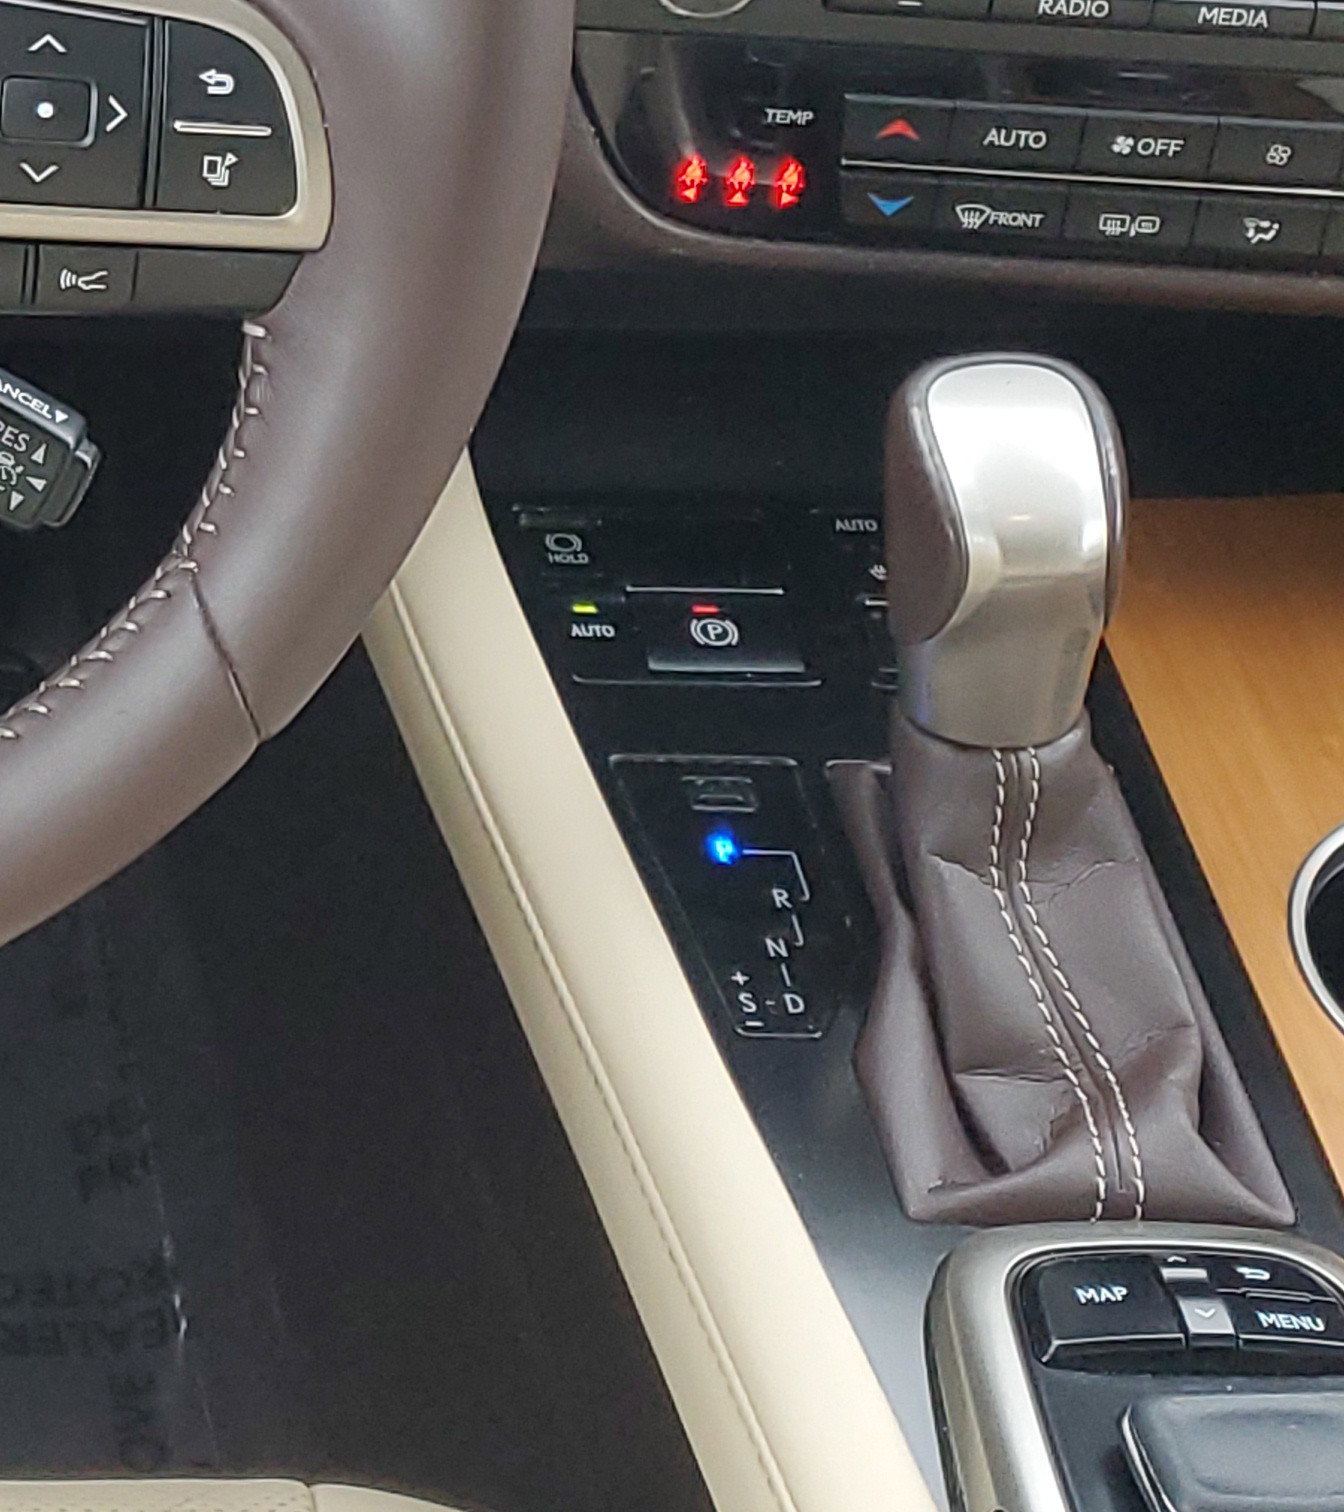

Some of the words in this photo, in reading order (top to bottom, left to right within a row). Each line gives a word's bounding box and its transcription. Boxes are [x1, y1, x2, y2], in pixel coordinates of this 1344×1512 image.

[1197, 6, 1269, 28] MEDIA
[765, 108, 814, 125] TEMP
[983, 129, 1047, 150] AUTO
[1136, 138, 1184, 158] OFF
[989, 210, 1043, 230] FRONT
[835, 518, 878, 533] AUTO
[548, 552, 589, 565] HOLD
[570, 623, 615, 639] AUTO
[771, 888, 792, 909] R
[765, 938, 788, 957] N
[738, 993, 757, 1013] S
[783, 993, 805, 1013] D
[1075, 1284, 1128, 1304] MAP
[1256, 1310, 1326, 1332] MENU
